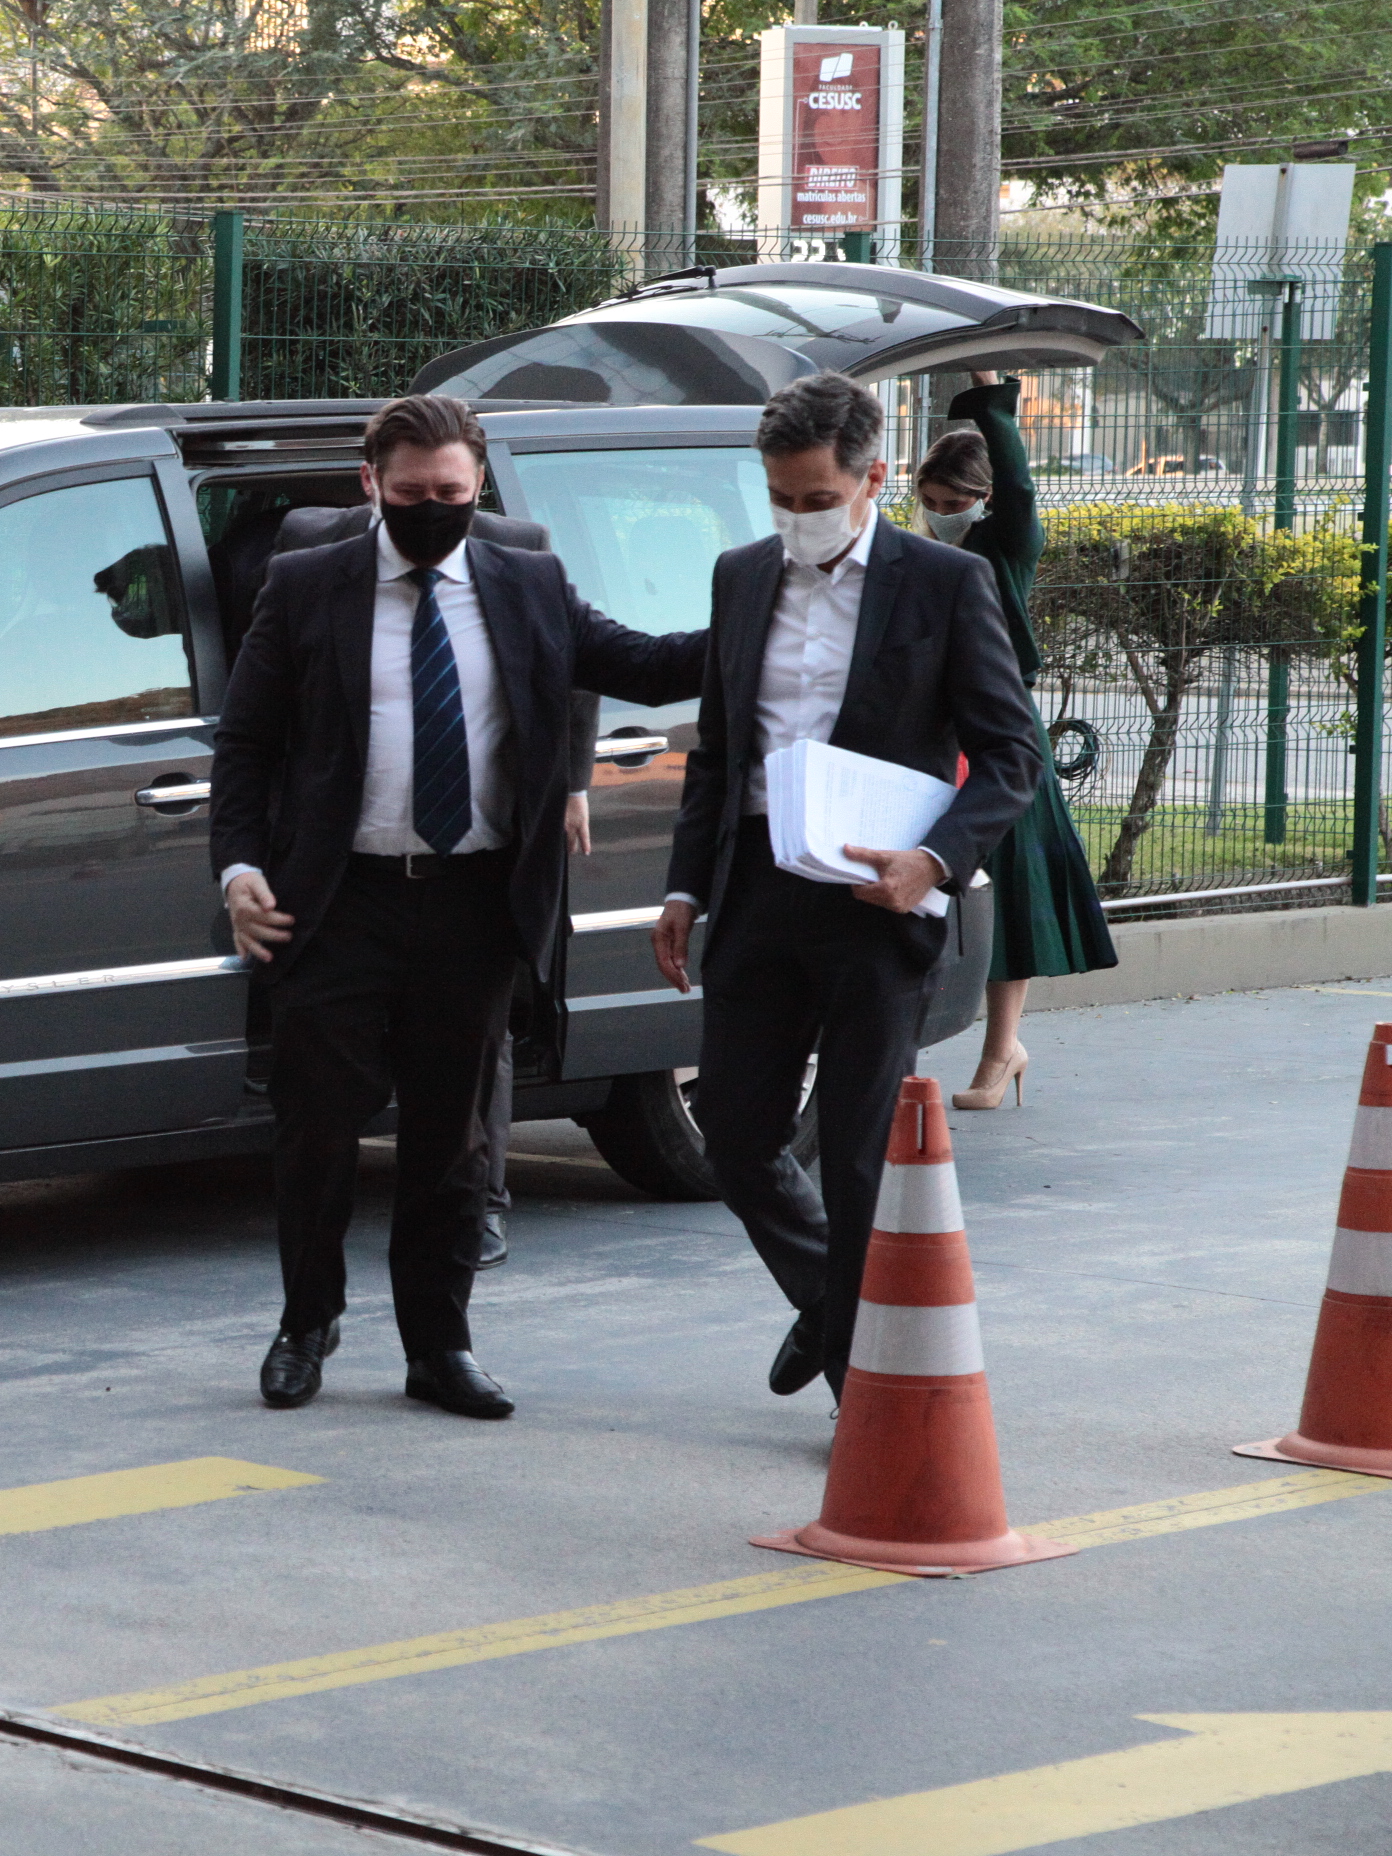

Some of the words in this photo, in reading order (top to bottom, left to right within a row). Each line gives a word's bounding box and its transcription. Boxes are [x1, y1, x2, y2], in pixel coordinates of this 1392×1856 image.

[809, 92, 862, 110] CESUSC
[808, 168, 856, 188] DIREITO
[837, 190, 866, 202] abertas
[803, 212, 857, 224] cesusc.edu.br
